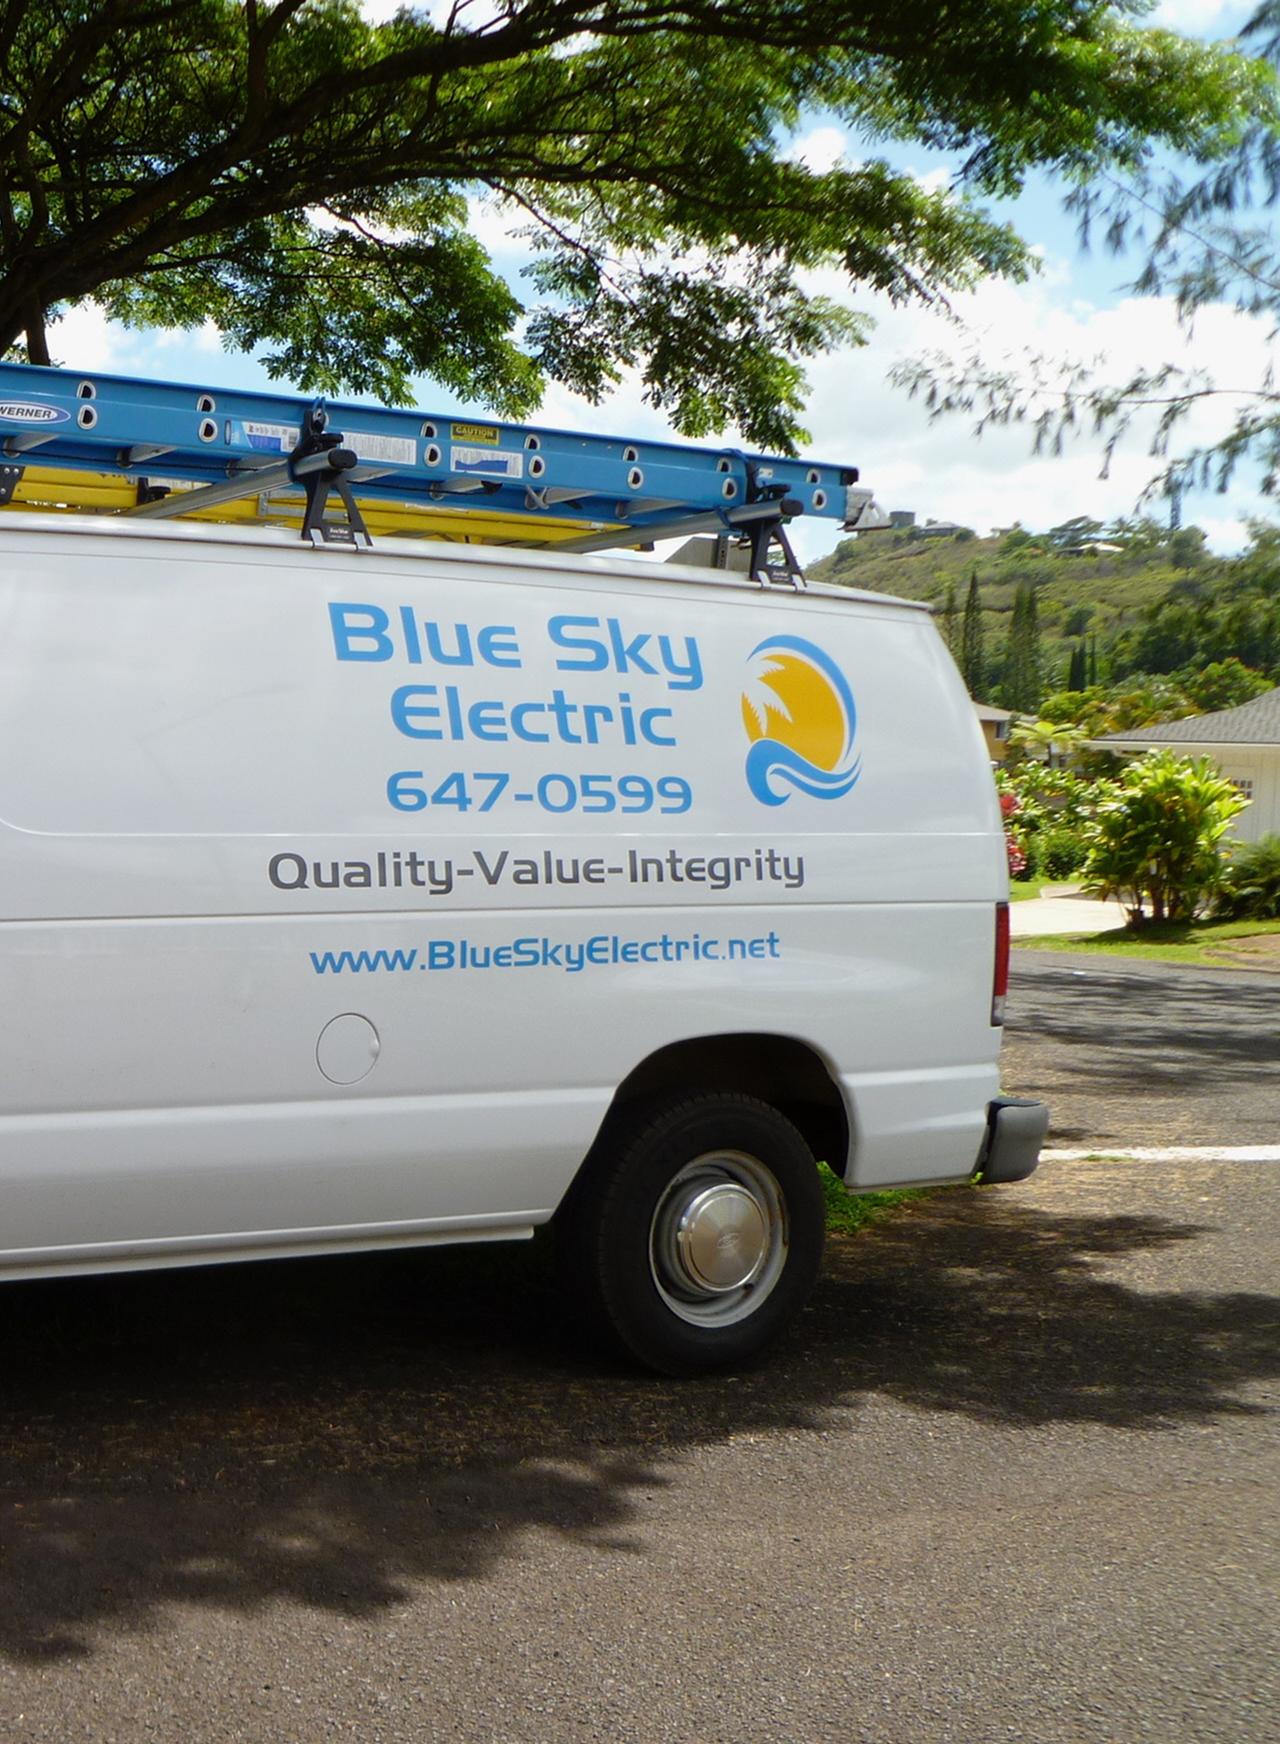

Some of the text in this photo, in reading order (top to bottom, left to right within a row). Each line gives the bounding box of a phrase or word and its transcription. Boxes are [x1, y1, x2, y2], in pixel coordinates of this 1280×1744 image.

[455, 426, 494, 437] CAUTION
[328, 602, 704, 691] Blue Sky
[390, 684, 677, 747] Electric
[386, 770, 693, 814] 647-0599
[268, 848, 805, 896] Quality-Value-Integrity
[309, 931, 781, 975] www.BlueSkyElectric.net
